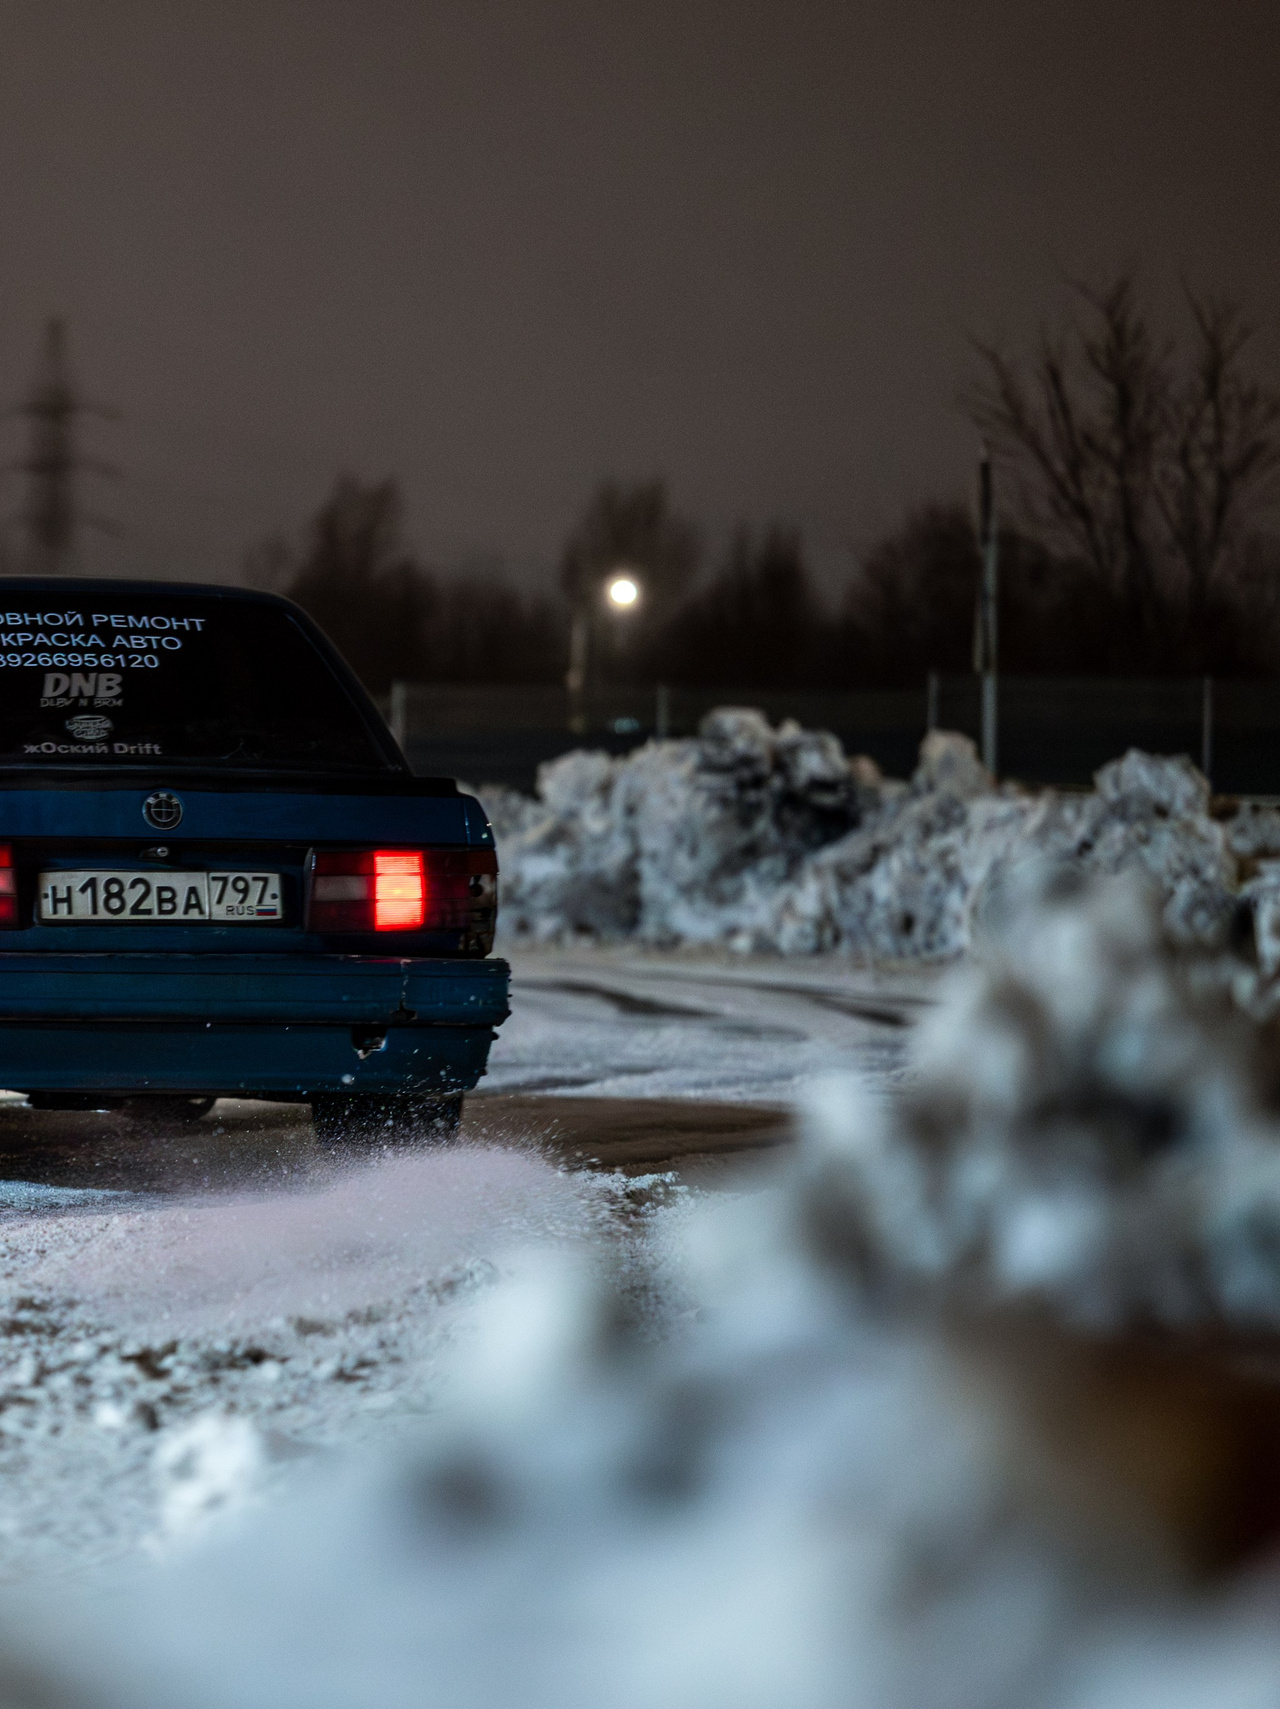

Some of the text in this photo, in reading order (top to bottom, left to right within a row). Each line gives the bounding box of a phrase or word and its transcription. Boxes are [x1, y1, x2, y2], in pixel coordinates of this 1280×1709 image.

[92, 614, 206, 632] РЕМОНТ
[112, 635, 182, 650] АВТО
[42, 672, 123, 698] DNB
[23, 741, 162, 755] жОский Drift
[211, 876, 269, 905] 797
[225, 905, 255, 916] RUS
